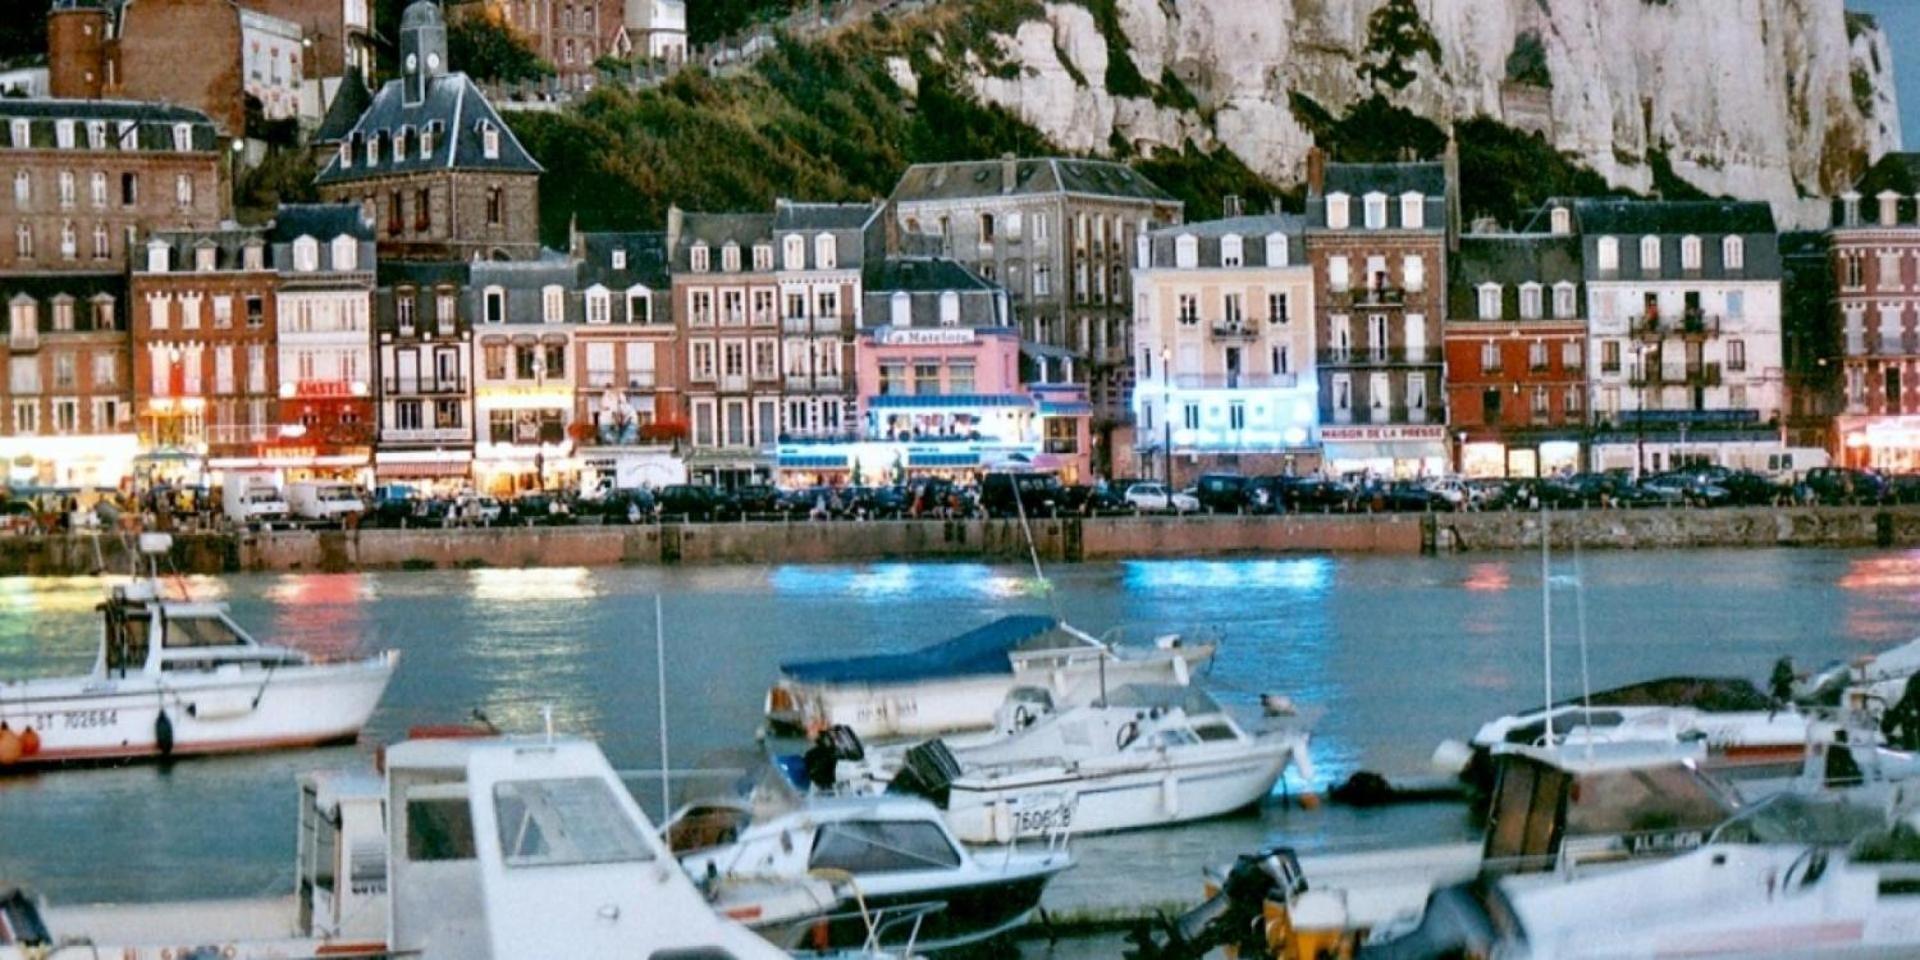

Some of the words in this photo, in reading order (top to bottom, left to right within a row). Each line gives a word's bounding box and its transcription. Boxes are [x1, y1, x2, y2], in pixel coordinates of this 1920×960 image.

[1321, 428, 1363, 439] MAISON
[1366, 428, 1380, 438] DE
[1382, 428, 1397, 438] LA
[1401, 427, 1442, 438] PRESSE
